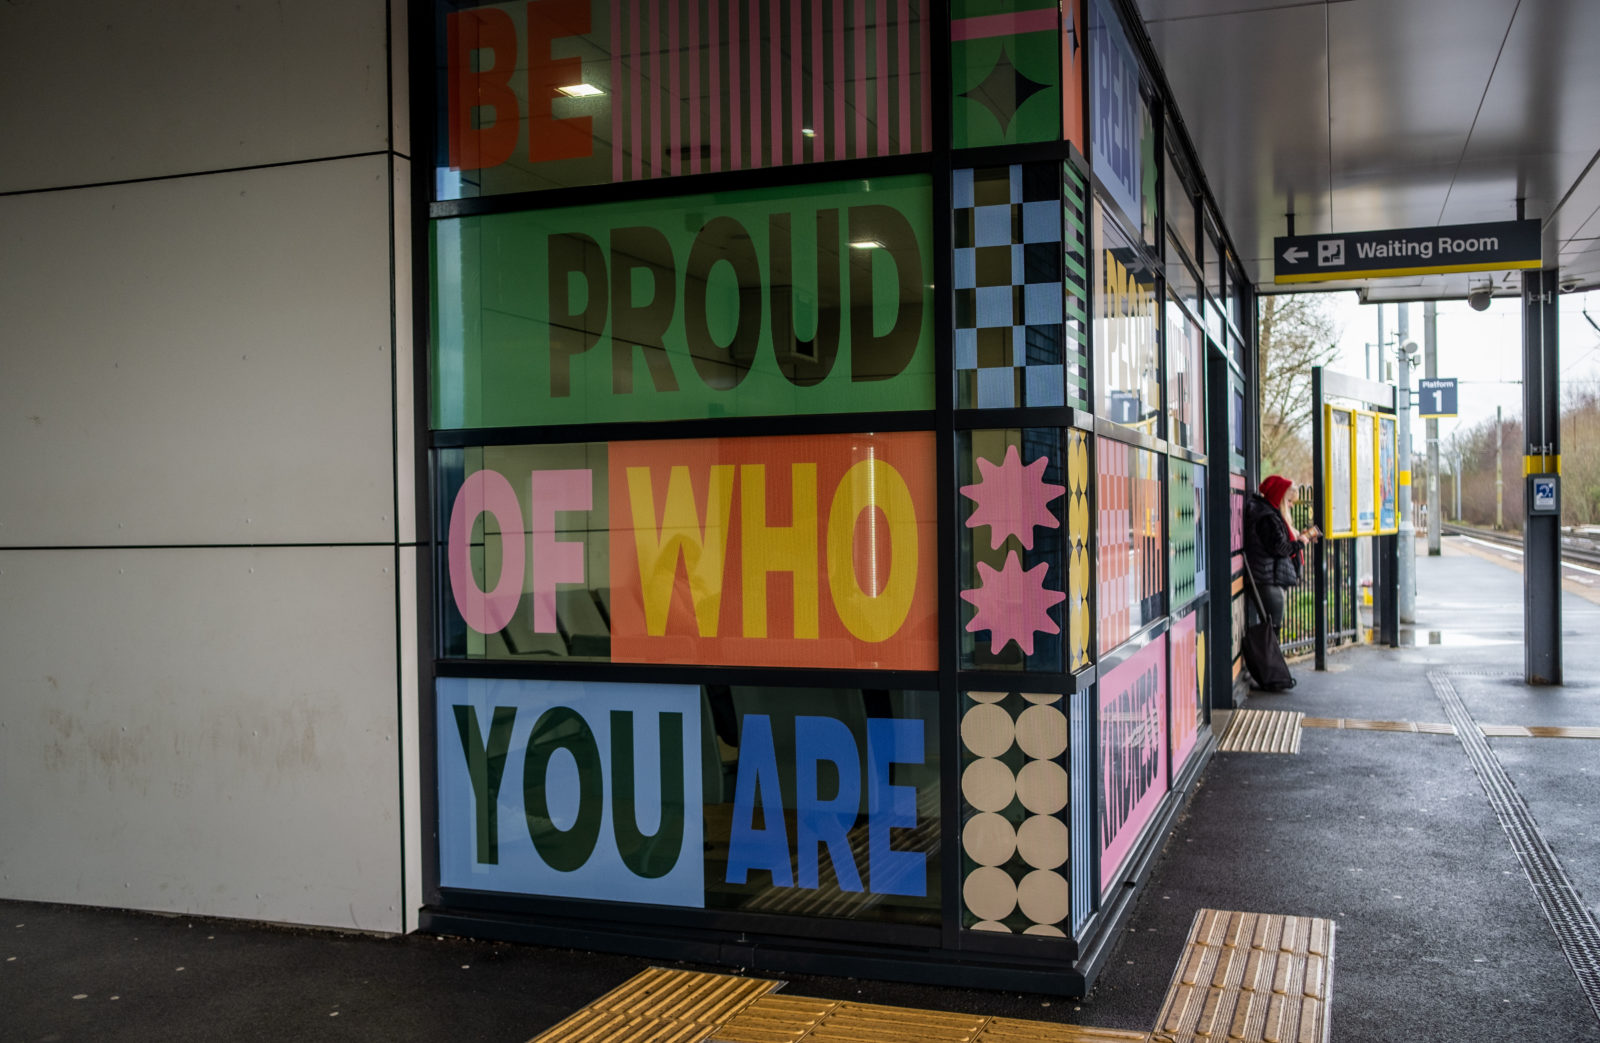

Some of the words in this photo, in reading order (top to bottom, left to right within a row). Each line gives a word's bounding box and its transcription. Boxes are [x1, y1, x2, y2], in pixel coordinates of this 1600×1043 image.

[447, 0, 593, 172] BE
[548, 204, 924, 398] PROUD
[1356, 240, 1433, 259] Waiting
[1438, 237, 1499, 254] Room
[1422, 381, 1454, 389] Platform
[1432, 390, 1442, 412] 1
[448, 469, 593, 635] OF
[626, 459, 919, 642] WHO
[1131, 476, 1162, 602] WITH
[452, 704, 686, 879] YOU
[725, 714, 927, 897] ARE
